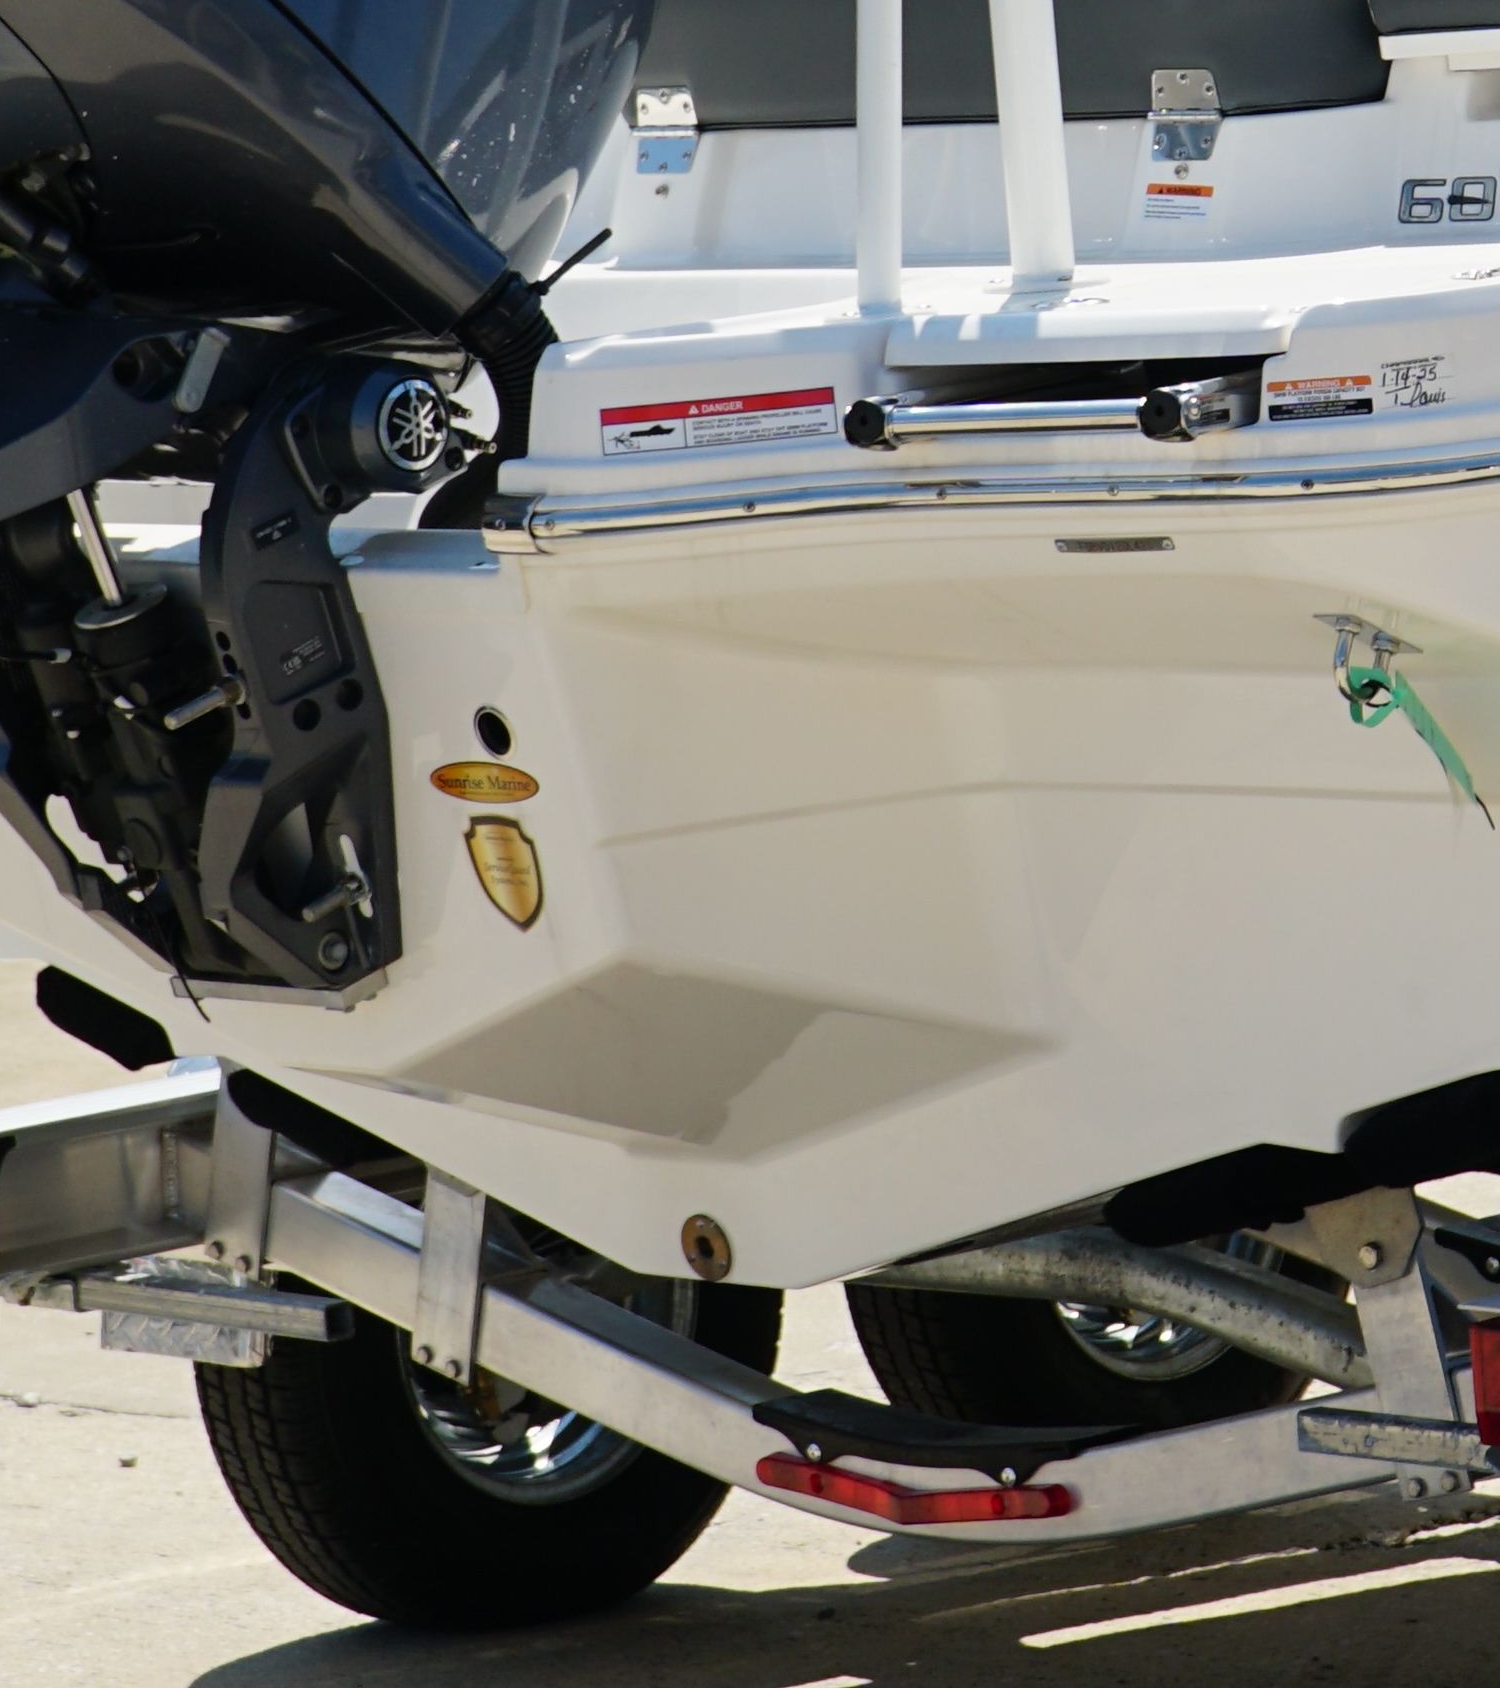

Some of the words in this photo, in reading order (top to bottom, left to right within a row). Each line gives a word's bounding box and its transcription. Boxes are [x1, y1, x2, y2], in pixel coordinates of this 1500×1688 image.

[1297, 379, 1341, 390] WARNING
[701, 401, 744, 414] DANGER
[437, 773, 485, 790] Sunrise
[486, 774, 533, 792] Marine
